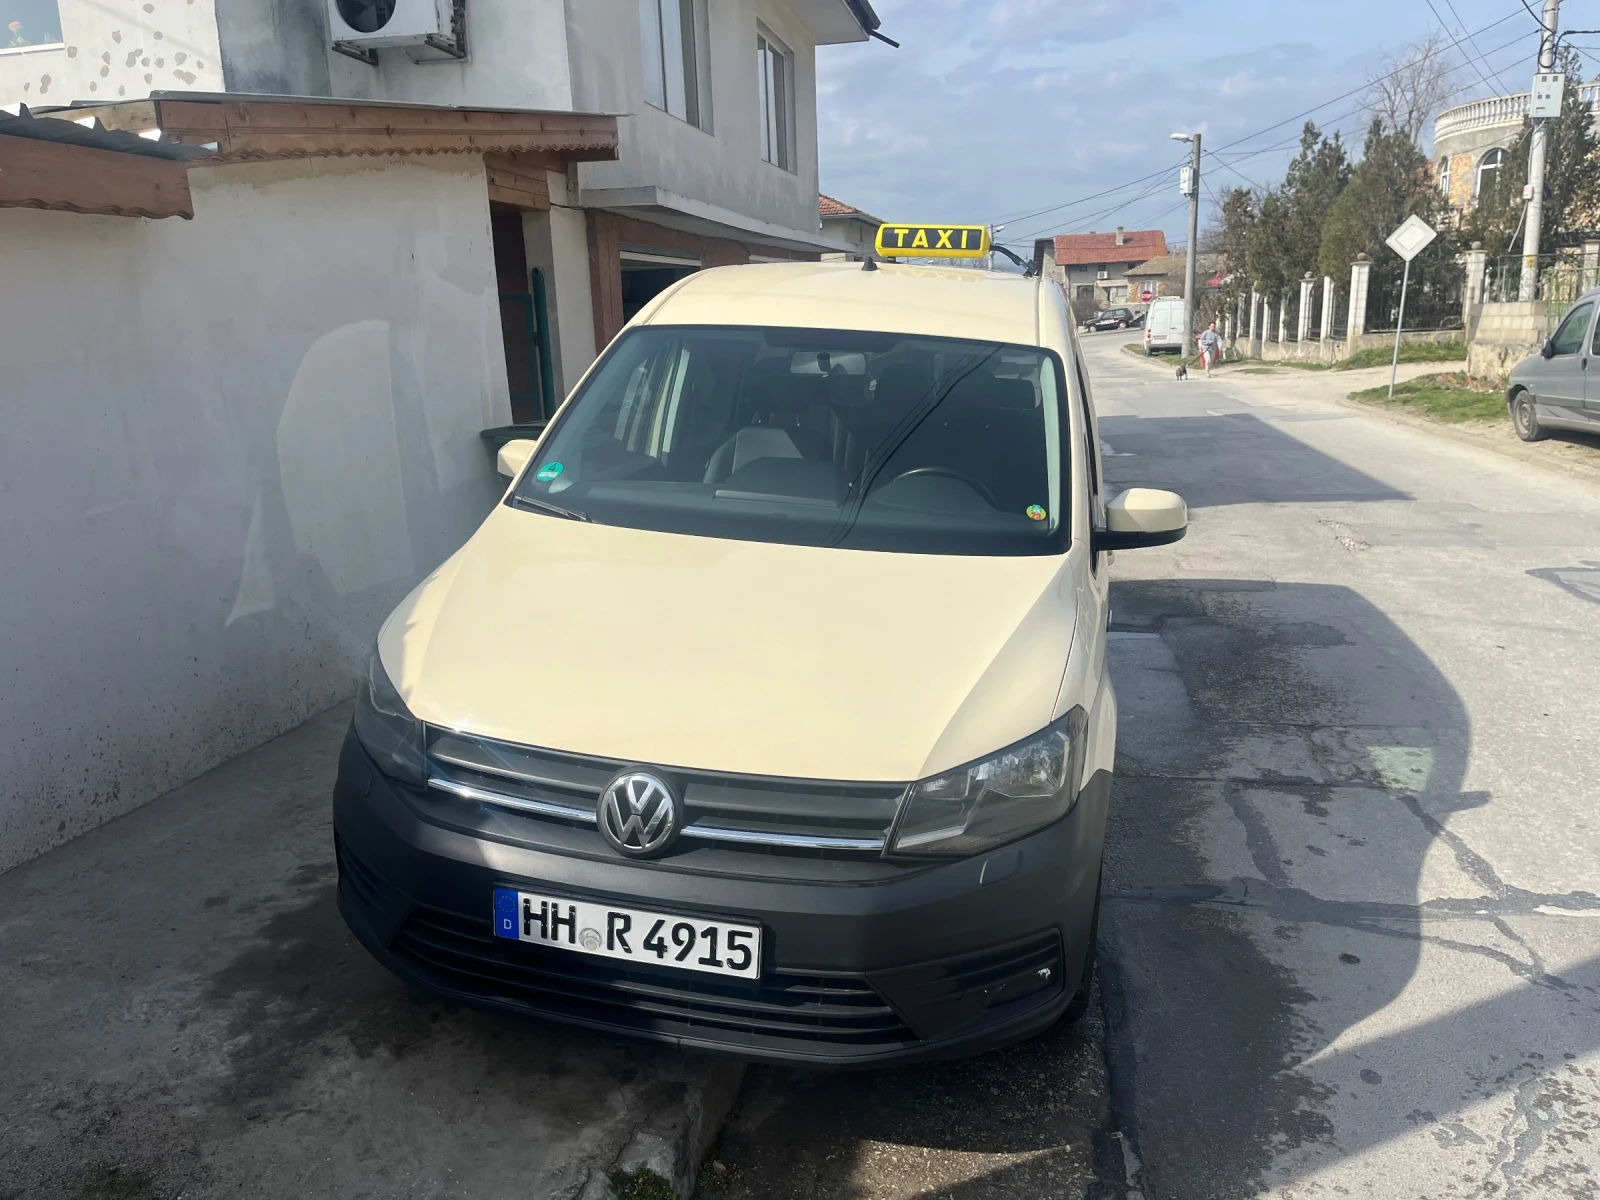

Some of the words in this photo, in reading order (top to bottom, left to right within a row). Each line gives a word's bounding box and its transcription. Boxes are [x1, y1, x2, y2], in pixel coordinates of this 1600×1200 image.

[894, 228, 968, 249] TAXI
[548, 462, 558, 471] 4
[602, 774, 672, 850] VW
[503, 918, 512, 930] D
[523, 897, 576, 944] HH
[607, 911, 632, 954] R
[643, 919, 753, 971] 4915
